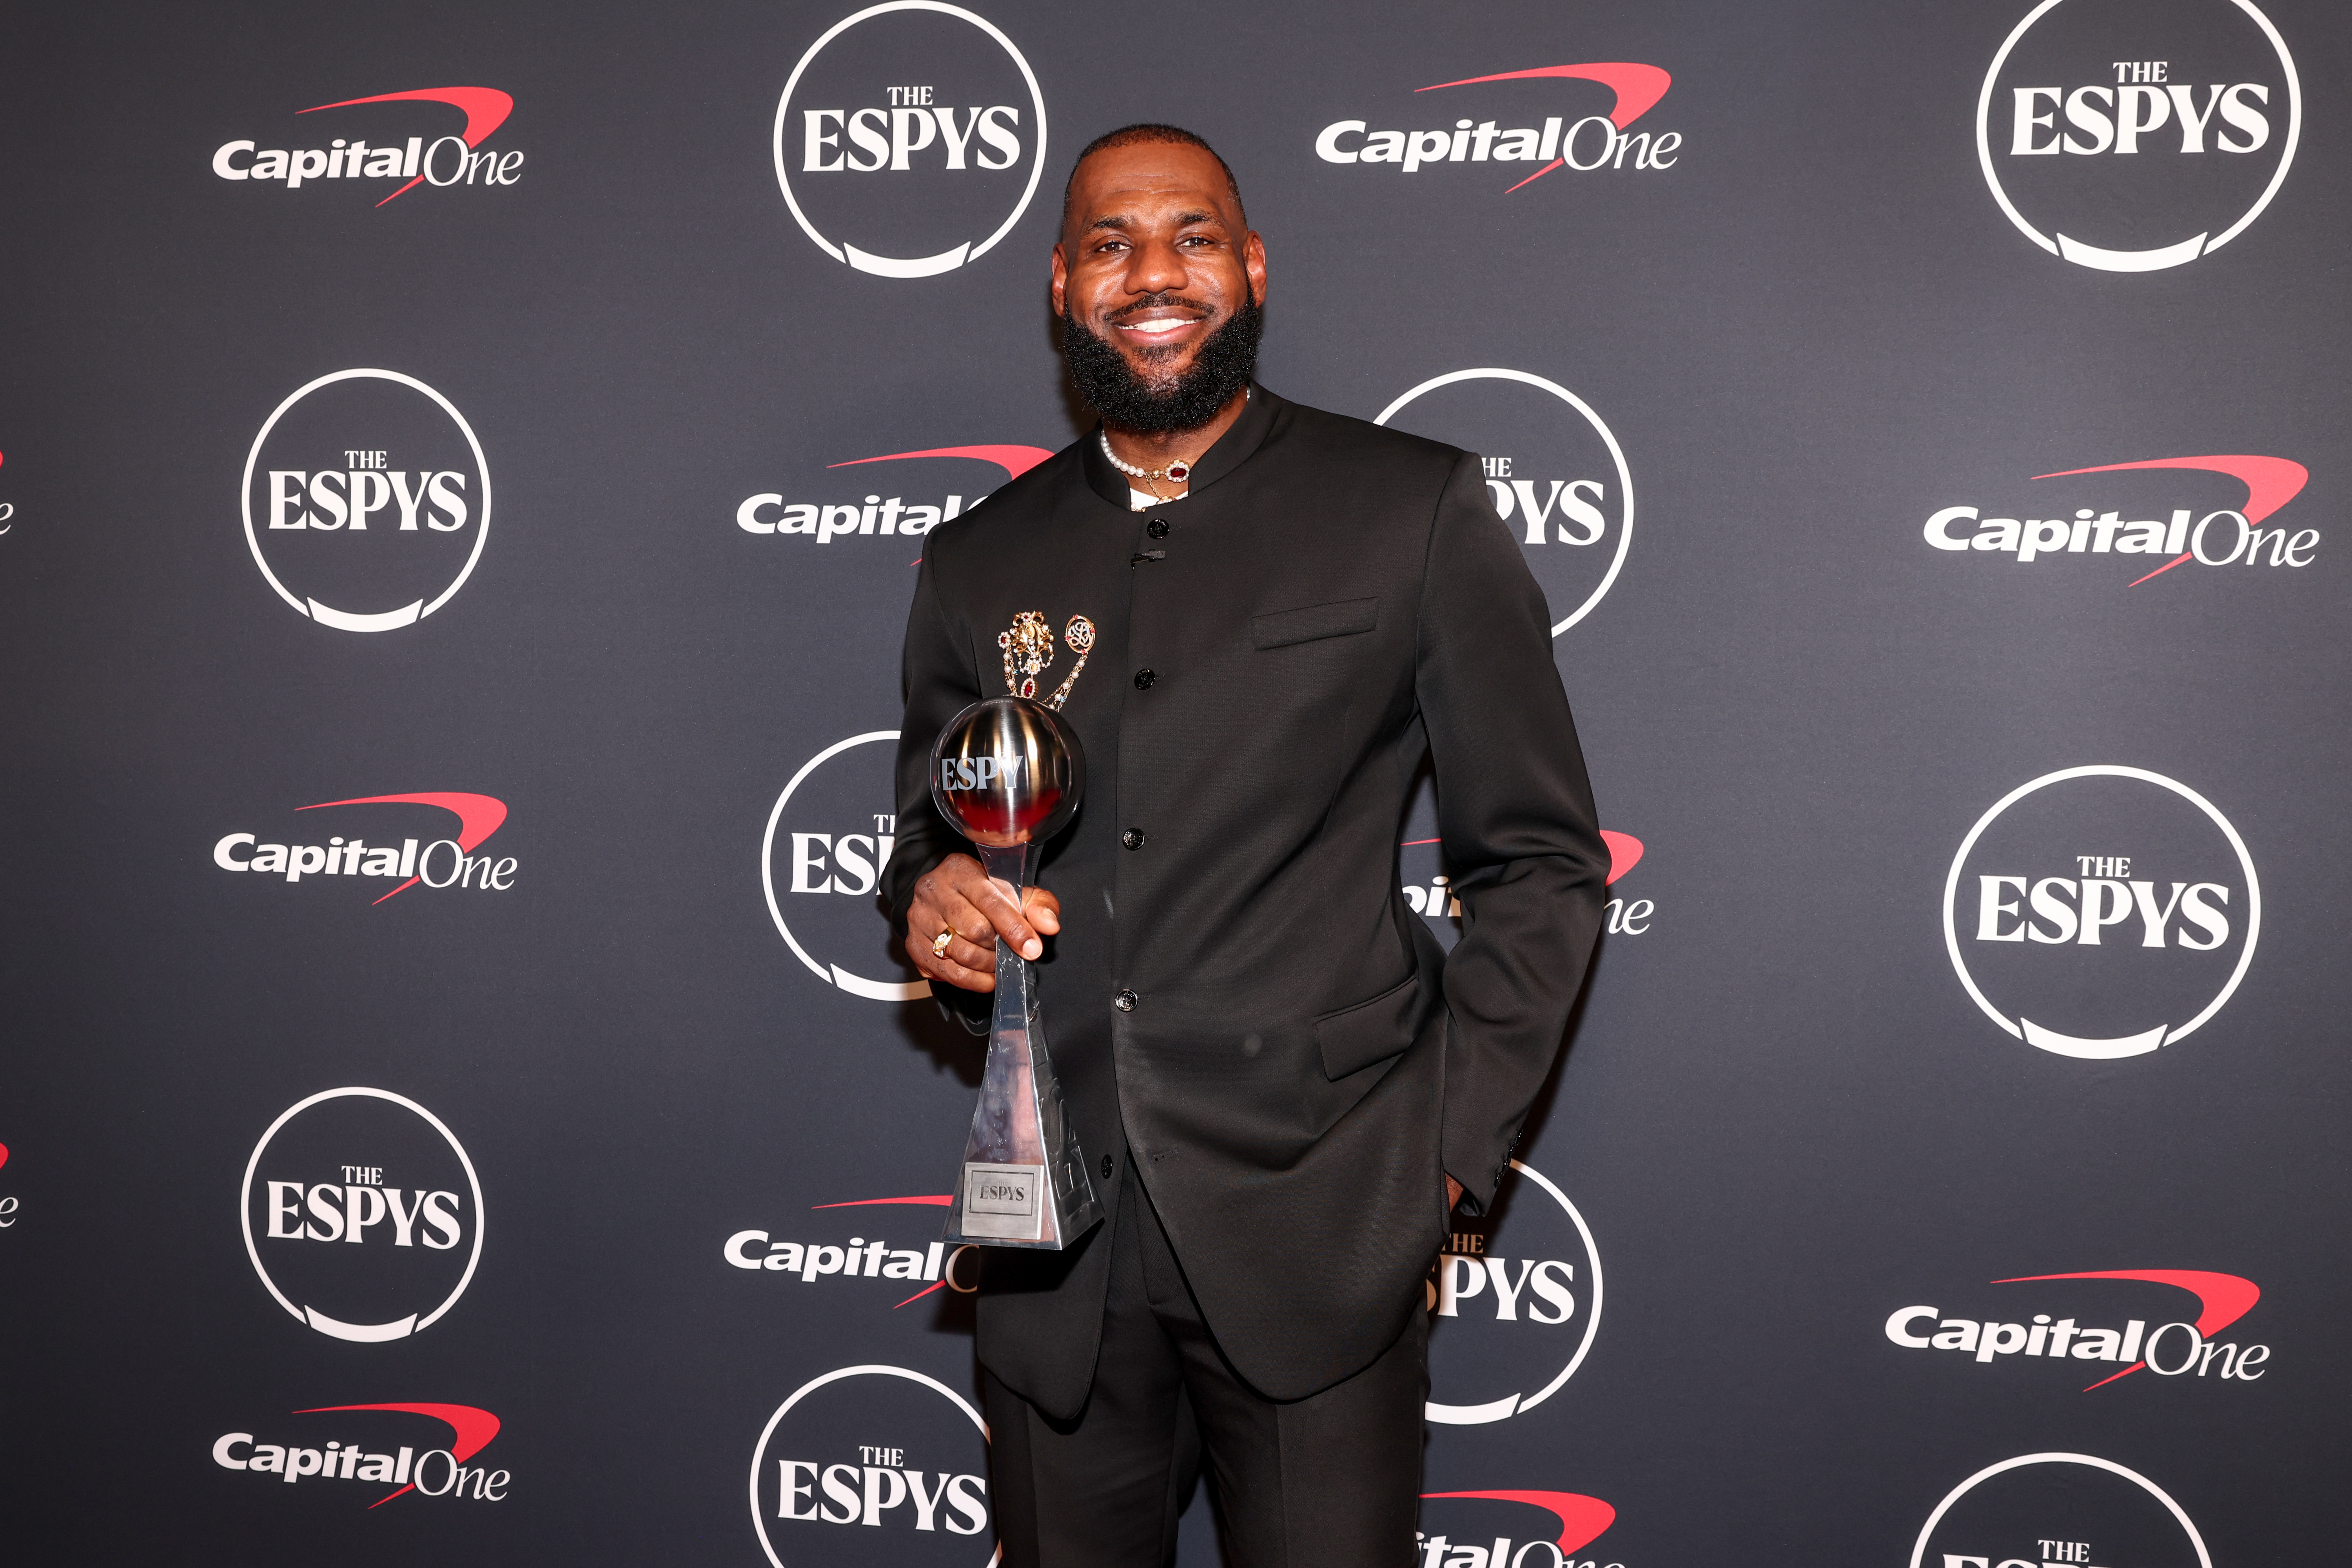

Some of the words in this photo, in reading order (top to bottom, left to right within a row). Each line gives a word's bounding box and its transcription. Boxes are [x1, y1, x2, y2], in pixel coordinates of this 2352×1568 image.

[2112, 61, 2168, 83] THE
[887, 86, 933, 106] THE
[2010, 83, 2269, 155] ESPYS
[802, 105, 1020, 172] ESPYS
[345, 450, 387, 469] THE
[1481, 457, 1512, 477] HE
[269, 470, 467, 532] ESPYS
[941, 755, 1024, 791] ESPY
[2076, 855, 2131, 878] THE
[1975, 875, 2229, 951] ESPYS
[341, 1165, 383, 1185] THE
[980, 1185, 1024, 1201] ESPYS
[267, 1181, 461, 1250] ESPYS
[724, 1230, 945, 1282] Capital
[1426, 1254, 1575, 1325] PYS
[859, 1446, 903, 1467] THE
[777, 1460, 987, 1535] ESPYS
[2038, 1539, 2090, 1563] THE
